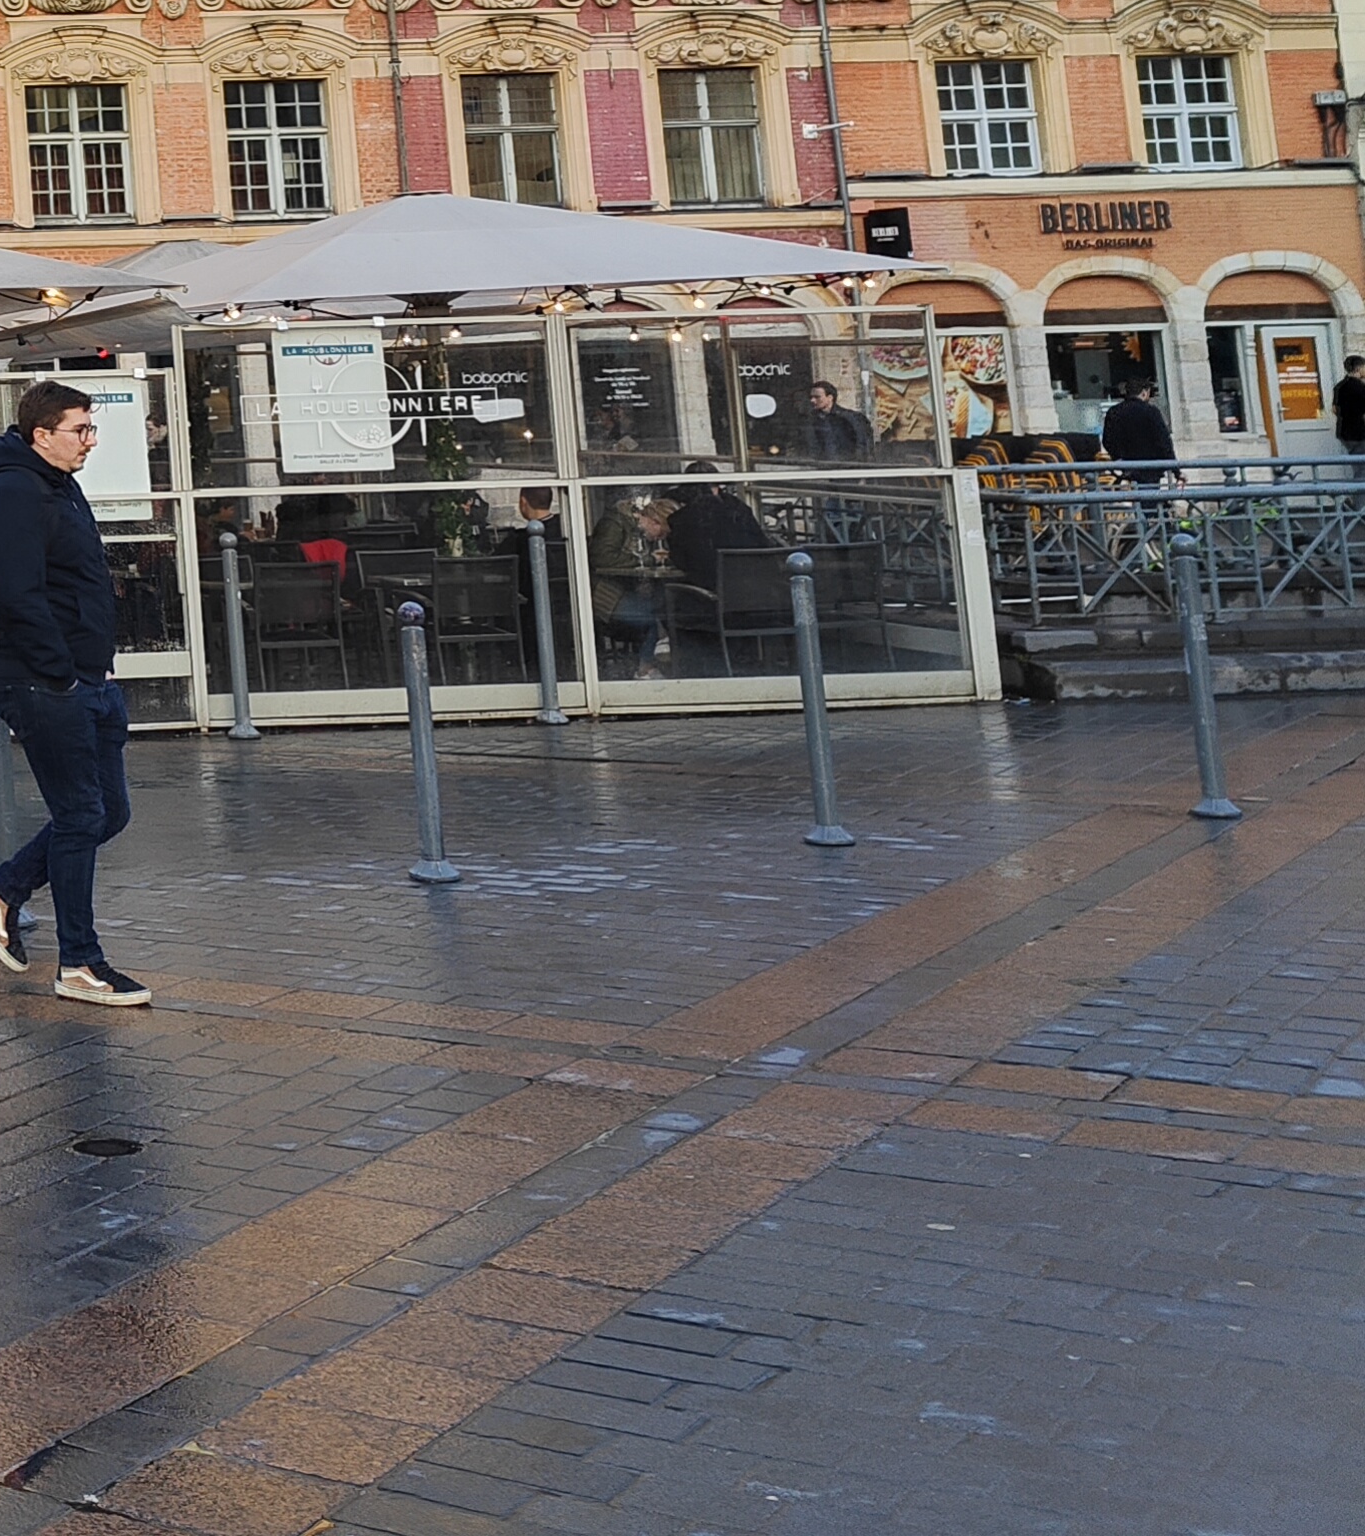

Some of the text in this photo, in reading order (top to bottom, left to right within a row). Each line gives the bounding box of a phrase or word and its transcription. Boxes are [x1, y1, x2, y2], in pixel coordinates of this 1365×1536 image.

[1041, 200, 1172, 234] BERLINER
[1095, 238, 1156, 249] ORIGINAL
[302, 346, 369, 354] HOUBLONNIERE
[461, 370, 529, 384] bobochic
[256, 395, 484, 417] LA HOUBLONNIERE
